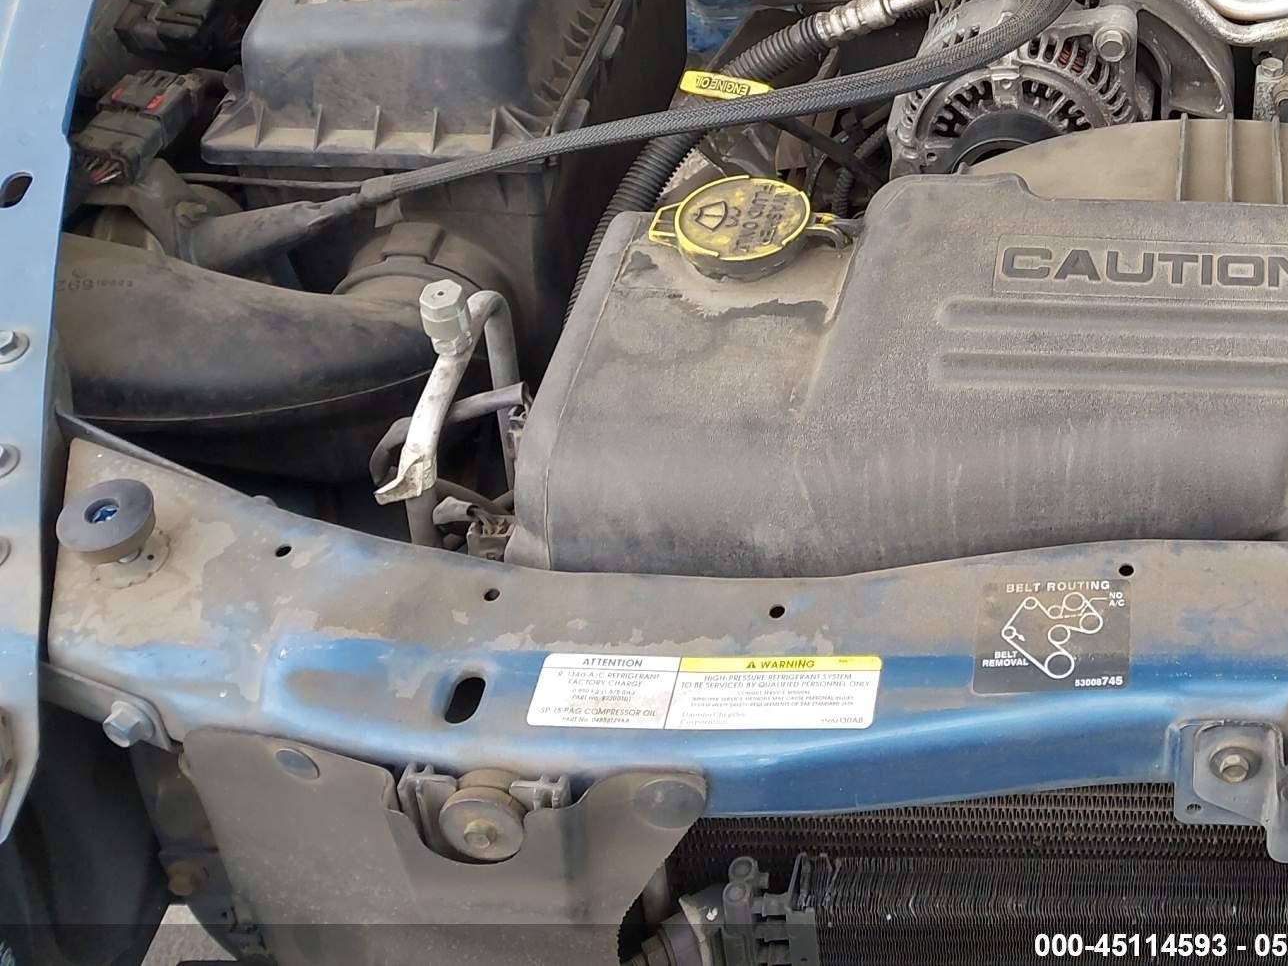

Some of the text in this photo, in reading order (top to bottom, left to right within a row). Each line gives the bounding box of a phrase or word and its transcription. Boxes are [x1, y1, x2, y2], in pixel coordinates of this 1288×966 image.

[710, 77, 751, 95] ENGINE
[1006, 580, 1110, 594] BELT ROUTING
[994, 651, 1018, 659] BELT
[582, 657, 643, 668] ATTENTION
[761, 659, 815, 669] WARNING
[982, 659, 1029, 668] REMOVAL
[607, 672, 660, 681] REFRIGERANT
[768, 673, 821, 681] REFRIGERANT
[822, 673, 852, 681] SYSTEM
[568, 678, 643, 688] FACTORY CHARGE
[681, 681, 692, 689] TO
[694, 681, 703, 689] BE
[705, 681, 744, 689] SERVICED
[746, 681, 757, 689] BY
[758, 681, 799, 689] QUALIFIED
[801, 680, 845, 688] PERSONNEL
[584, 706, 642, 717] COMPRESSOR
[642, 708, 656, 717] OIL
